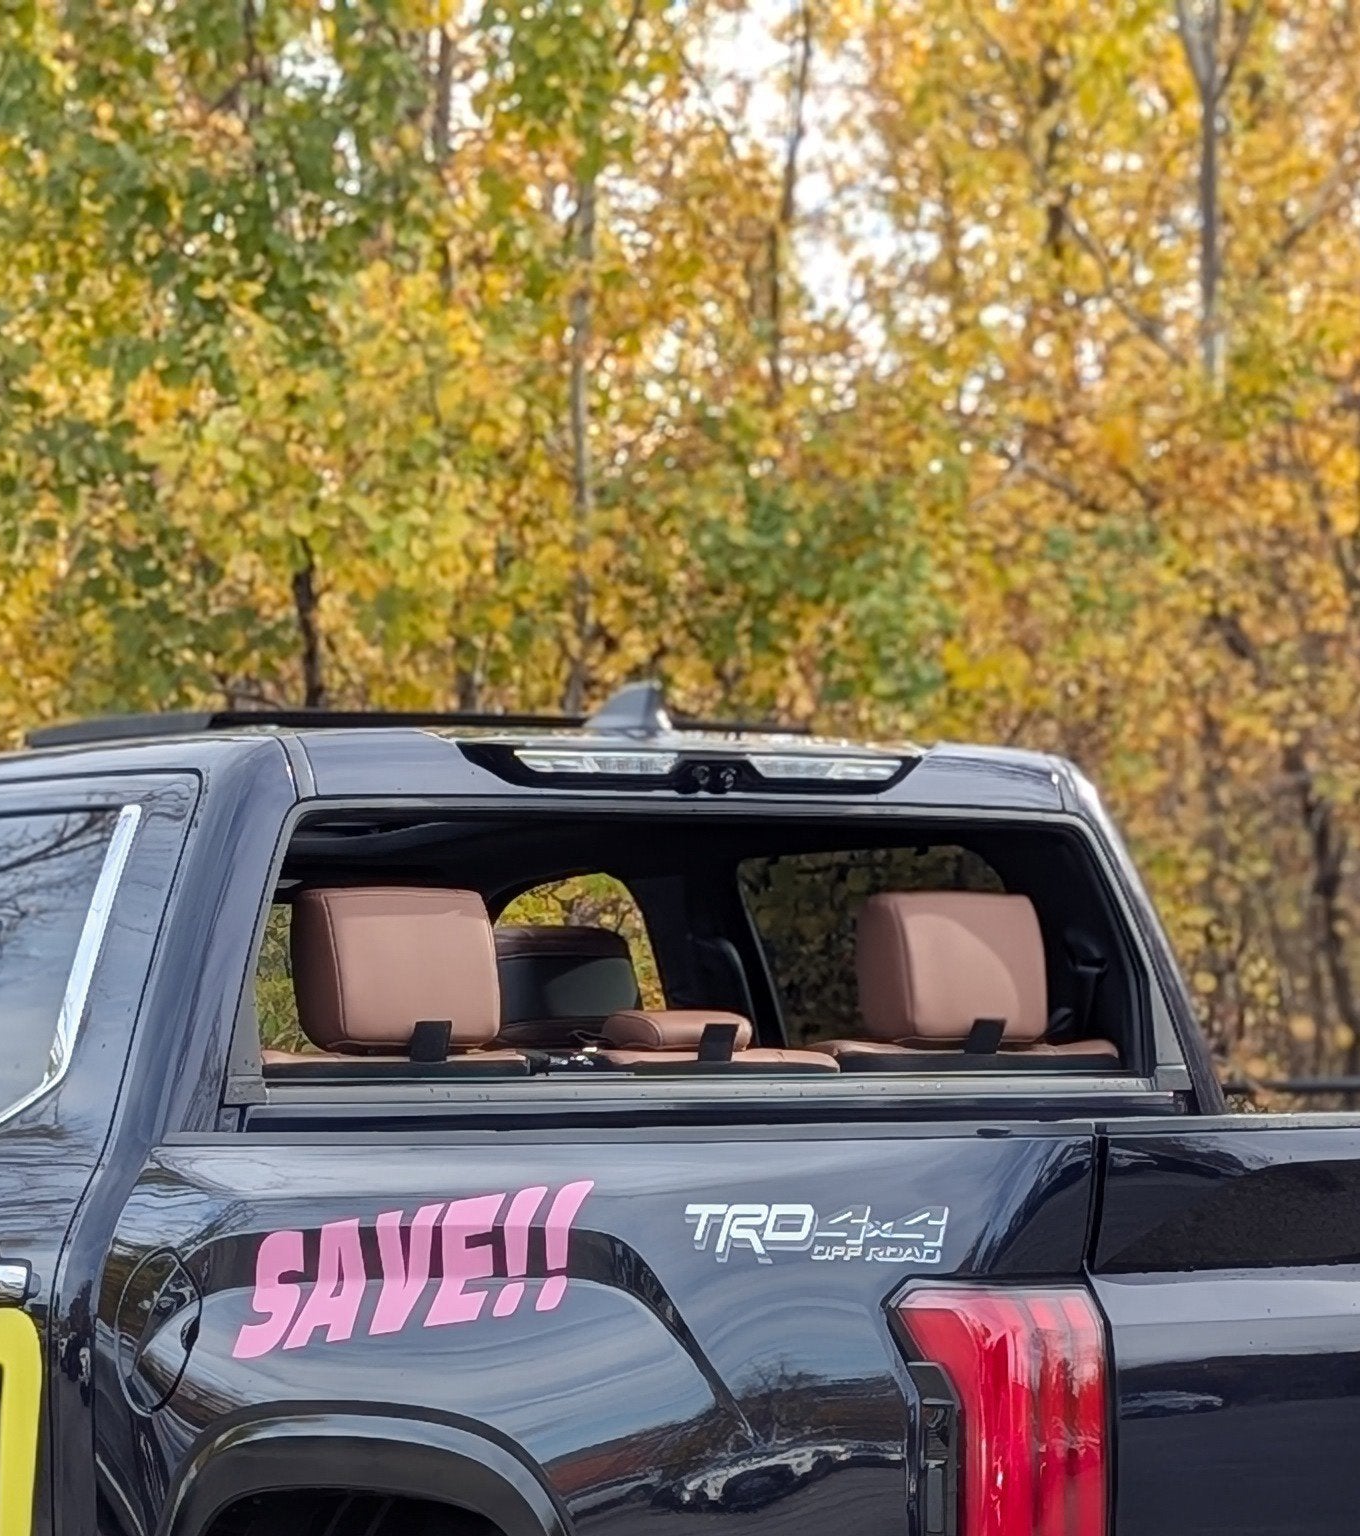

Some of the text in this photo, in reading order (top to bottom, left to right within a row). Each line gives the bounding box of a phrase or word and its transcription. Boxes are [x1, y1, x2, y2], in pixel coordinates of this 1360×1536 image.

[684, 1203, 819, 1264] TRD
[810, 1243, 942, 1265] OFF ROAD
[232, 1179, 596, 1360] SAVE!!
